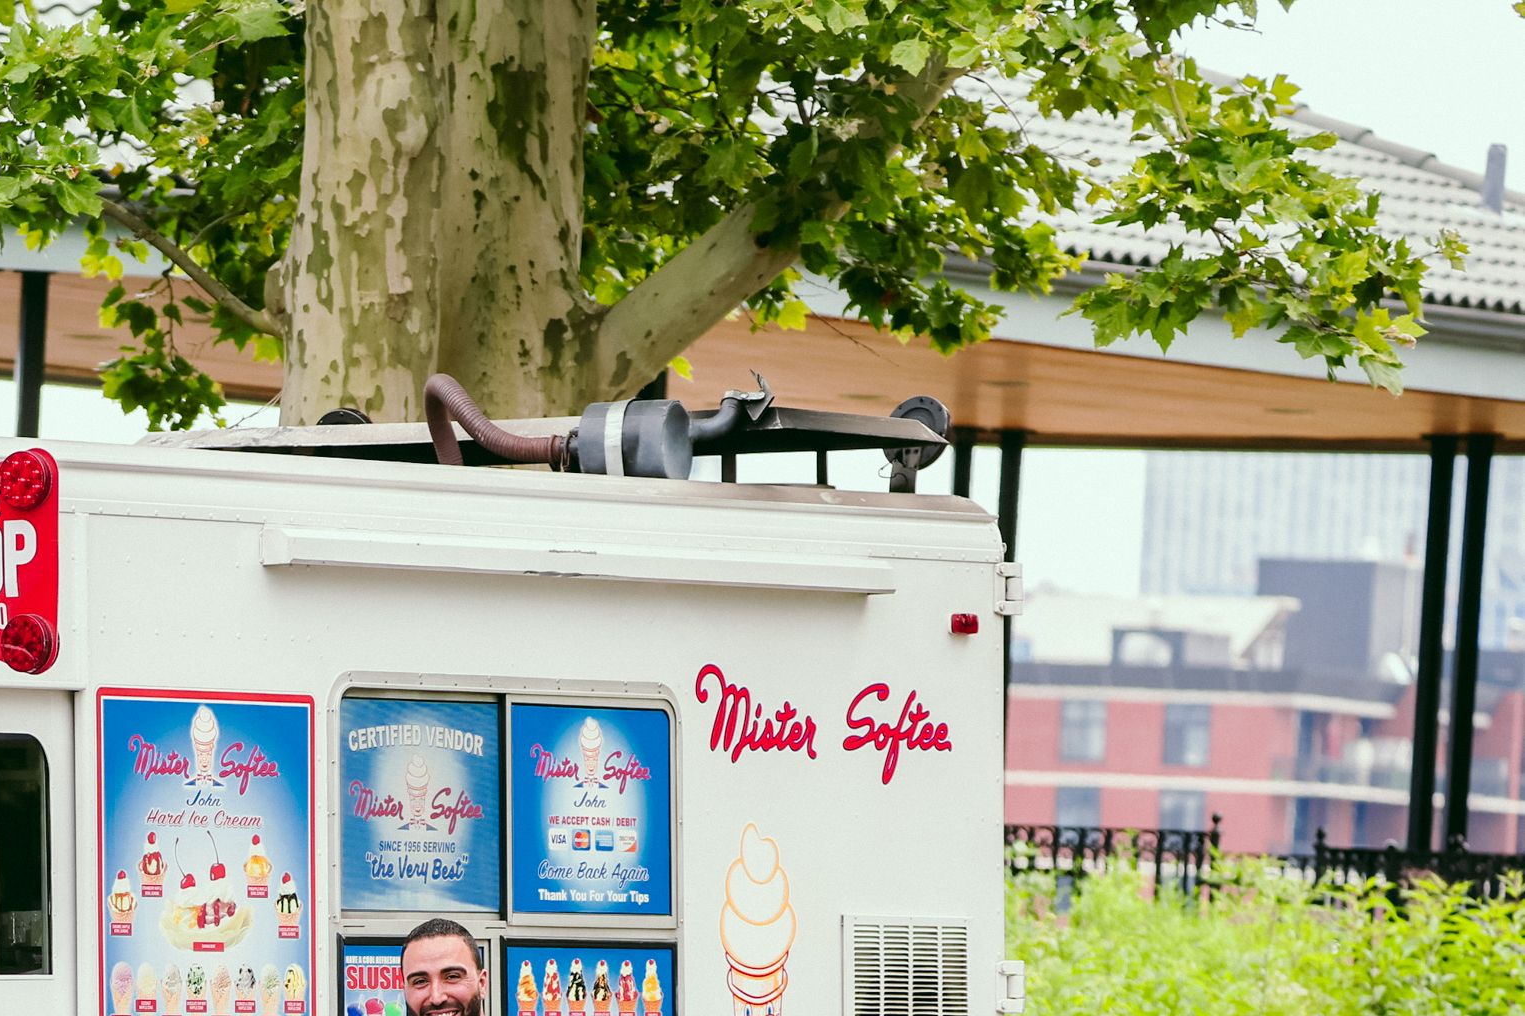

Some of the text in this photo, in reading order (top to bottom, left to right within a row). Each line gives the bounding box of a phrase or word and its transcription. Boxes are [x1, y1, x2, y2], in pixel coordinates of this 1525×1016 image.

[695, 664, 953, 785] Mister Softee
[348, 724, 484, 756] CERTIFIED VENDOR
[129, 734, 279, 795] Mister Softee
[530, 743, 652, 795] Mister Softee
[186, 790, 222, 806] John
[350, 780, 484, 835] Mister Softee
[573, 792, 607, 808] John
[147, 809, 263, 827] Hard Ice Cream
[549, 816, 561, 825] WE
[562, 816, 590, 825] ACCEPT
[591, 817, 611, 826] CASH
[616, 817, 637, 826] DEBIT
[379, 840, 456, 853] SINCE 1956 SERVING
[550, 835, 567, 845] VISA
[399, 855, 429, 884] Very
[538, 860, 649, 888] Come Back Again
[538, 888, 650, 905] Thank You For Your Tips
